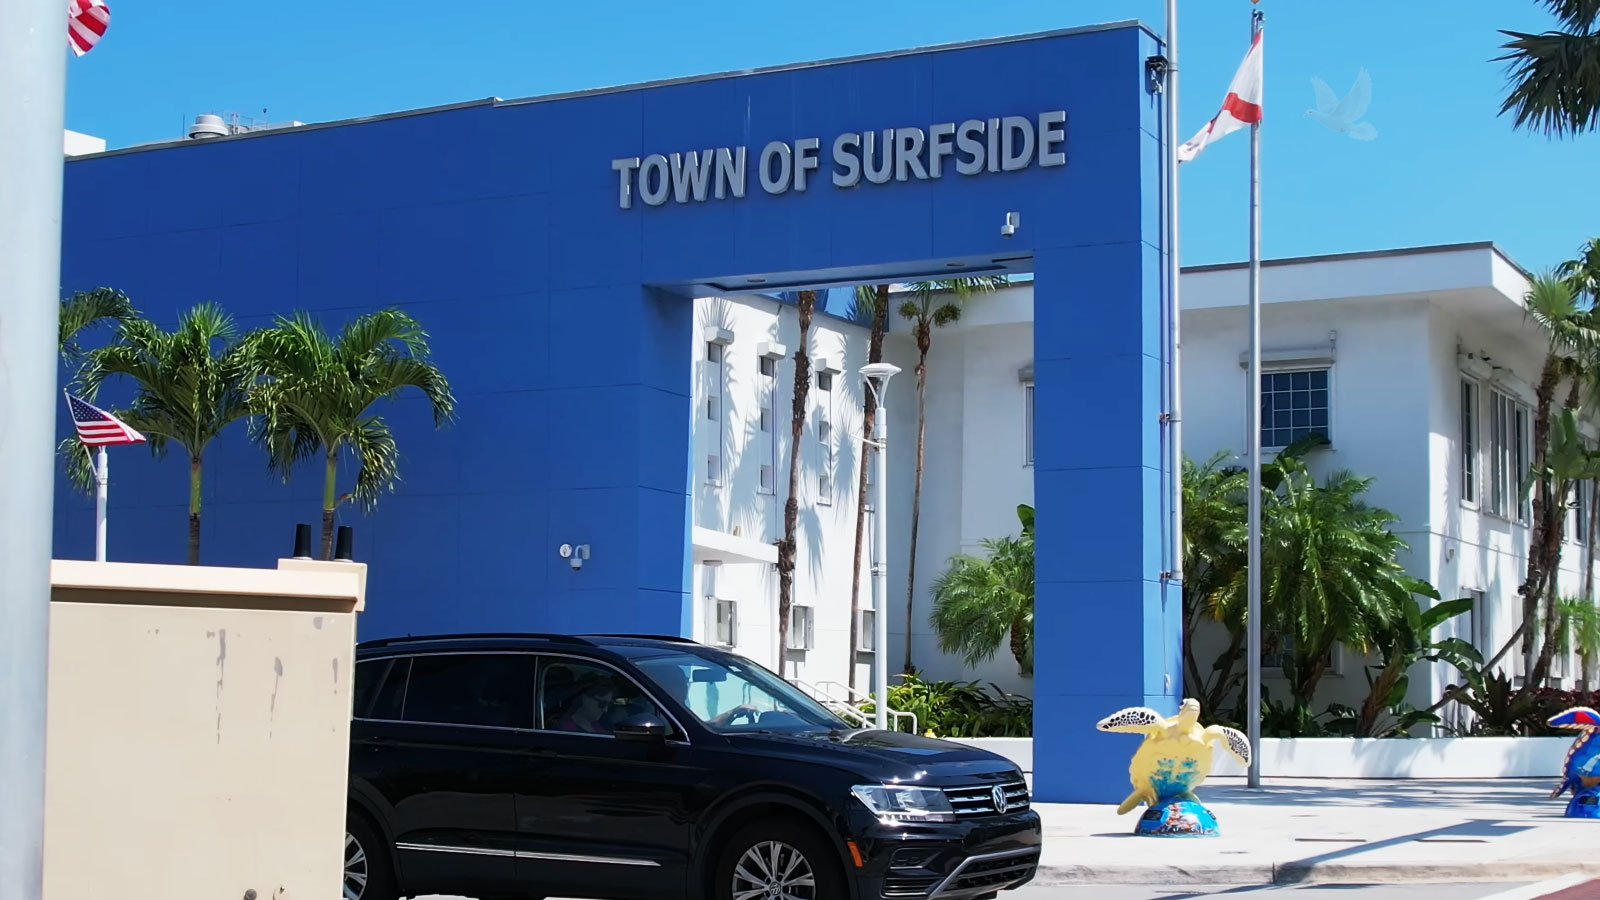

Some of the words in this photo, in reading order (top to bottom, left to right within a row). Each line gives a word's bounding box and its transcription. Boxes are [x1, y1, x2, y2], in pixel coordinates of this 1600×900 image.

[611, 146, 746, 208] TOWN
[758, 137, 820, 195] OF
[832, 110, 1067, 188] SURFSIDE
